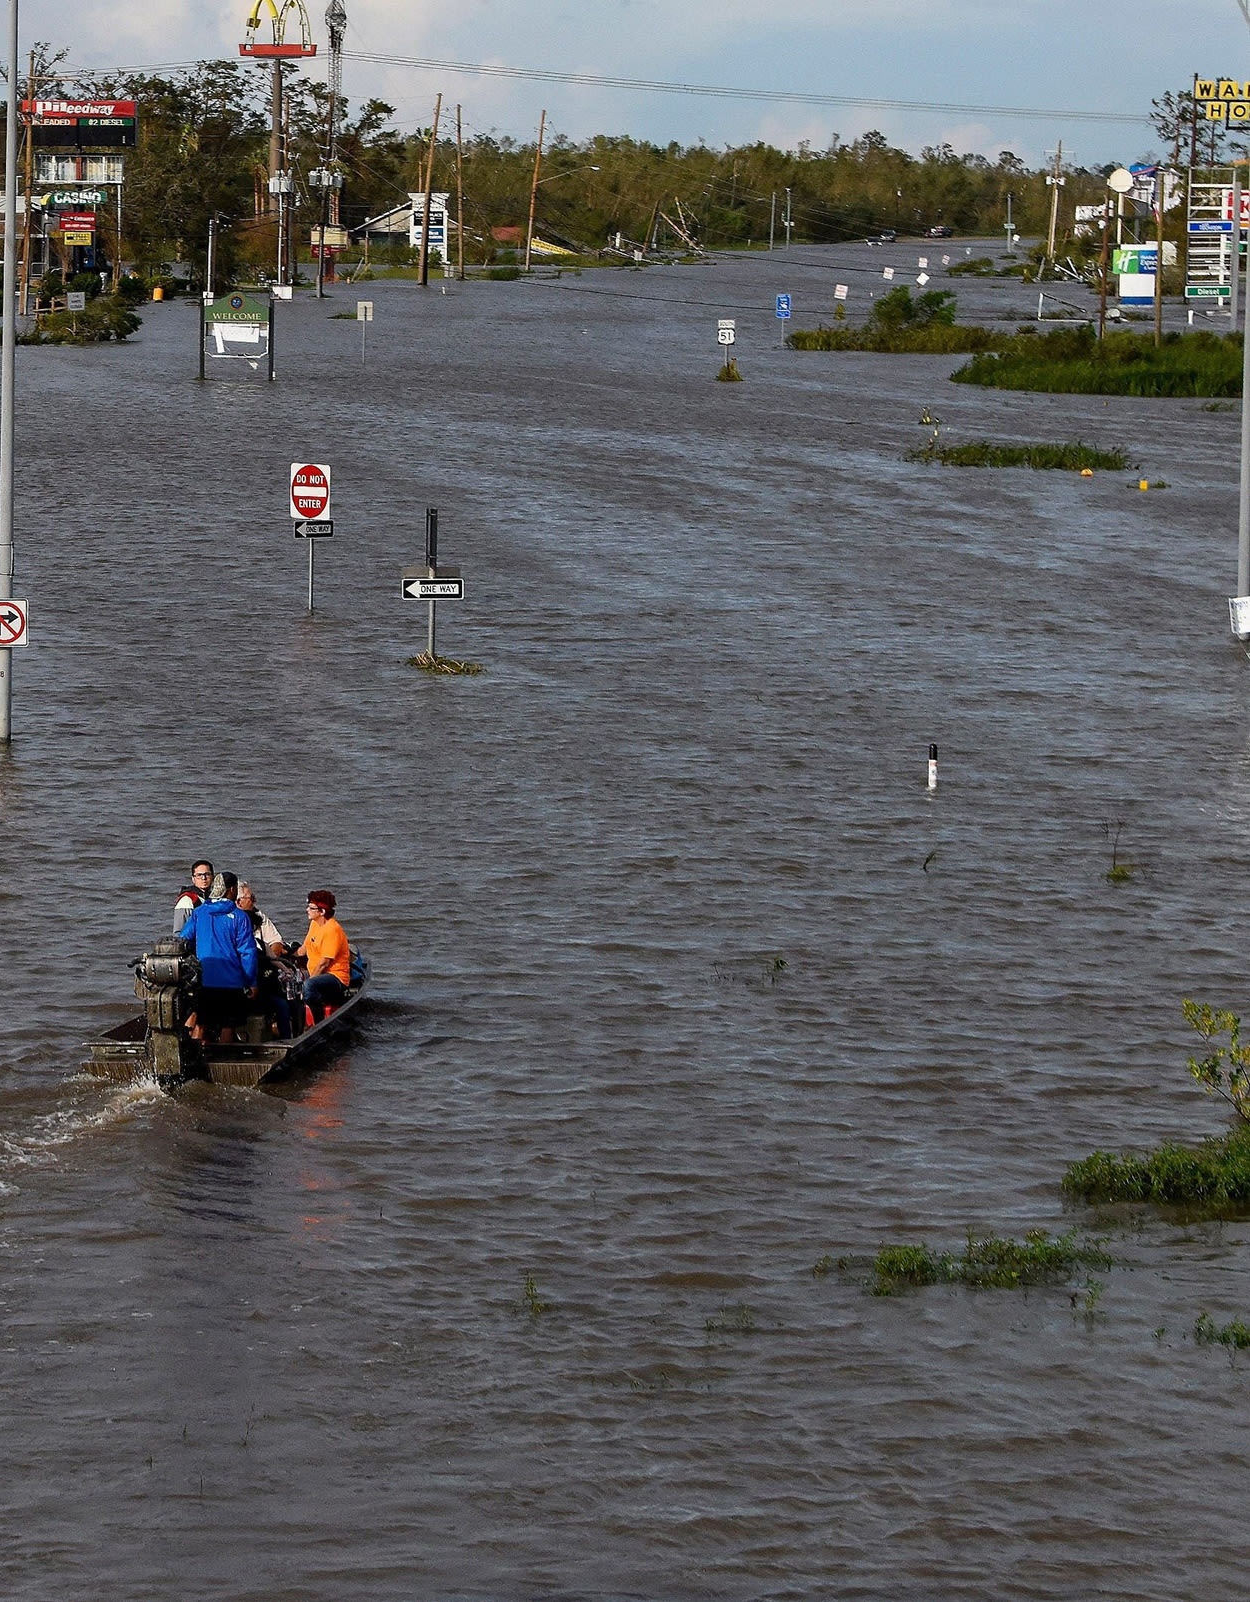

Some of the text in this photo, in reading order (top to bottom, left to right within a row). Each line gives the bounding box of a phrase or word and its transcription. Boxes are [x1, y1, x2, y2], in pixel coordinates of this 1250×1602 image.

[1199, 83, 1250, 97] WA
[1197, 288, 1220, 296] Diesel
[212, 312, 262, 321] WELCOME
[720, 331, 731, 341] 51
[296, 474, 324, 485] DO NOT
[299, 499, 321, 508] ENTER
[317, 525, 330, 533] WAY
[420, 585, 457, 594] ONE WAY
